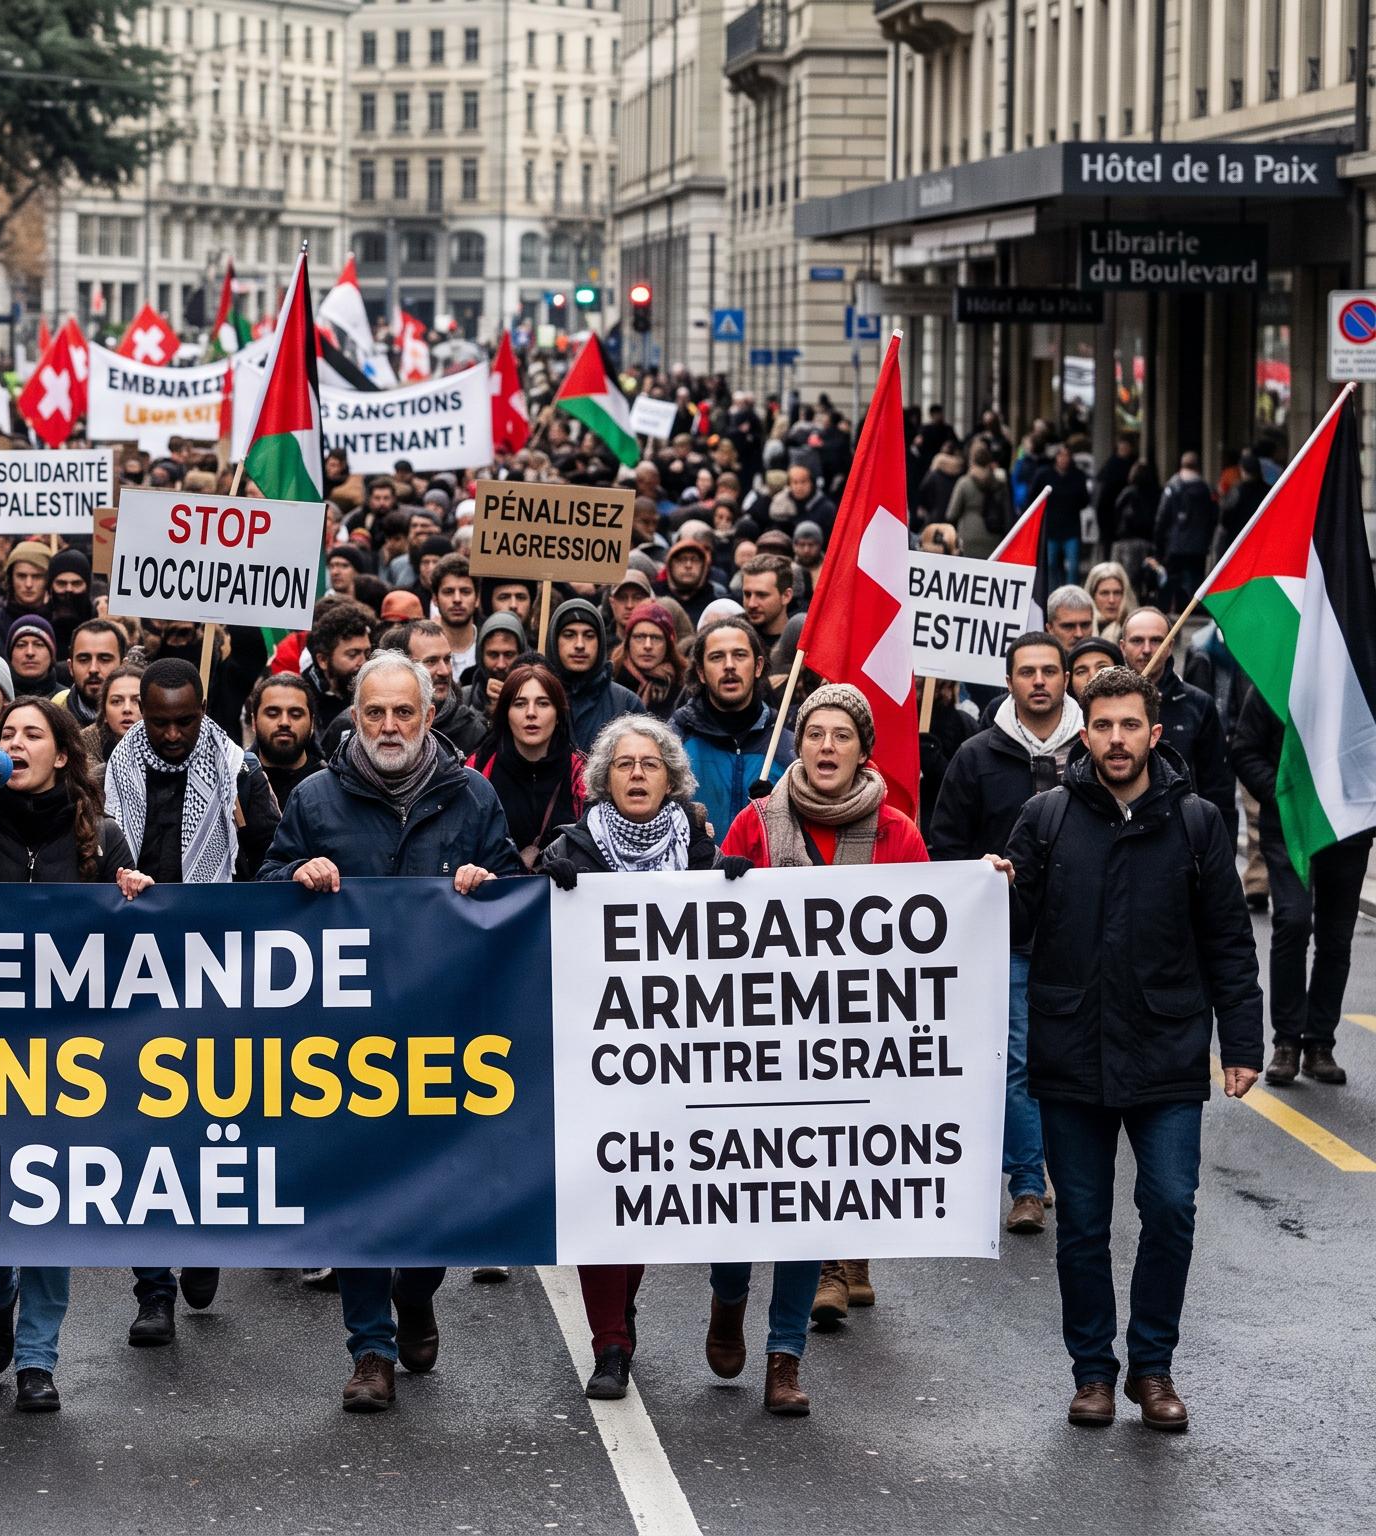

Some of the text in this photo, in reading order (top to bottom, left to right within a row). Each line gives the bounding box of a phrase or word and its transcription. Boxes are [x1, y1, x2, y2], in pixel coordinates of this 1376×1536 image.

[1081, 153, 1319, 184] Hôtel de la Paix
[1090, 230, 1200, 254] Librairie
[1089, 258, 1258, 284] du Boulevard
[966, 297, 1012, 314] Hôtel
[1016, 297, 1037, 314] de
[1040, 298, 1055, 314] la
[337, 391, 463, 420] SANCTIONS
[458, 424, 465, 445] !
[168, 503, 272, 549] STOP
[483, 490, 624, 529] PÉNALISEZ
[480, 531, 622, 564] L'AGRESSION
[117, 555, 310, 610] L'OCCUPATION
[909, 566, 1027, 610] BAMENT
[913, 610, 1021, 658] ESTINE
[603, 894, 948, 962] EMBARGO
[593, 966, 958, 1030] ARMEMENT
[137, 1034, 516, 1119] SUISSES
[591, 1024, 963, 1086] CONTRE ISRAËL
[596, 1122, 962, 1174] CH: SANCTIONS
[615, 1177, 947, 1227] MAINTENANT!
